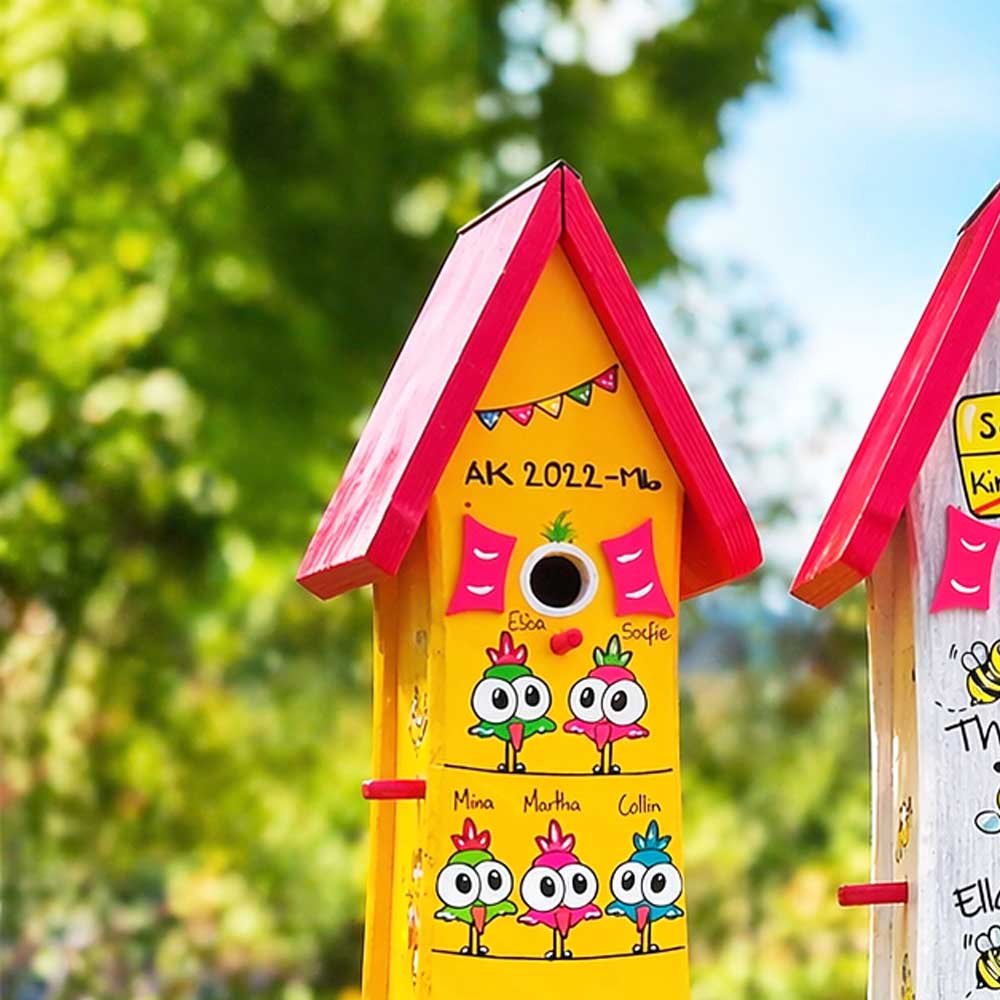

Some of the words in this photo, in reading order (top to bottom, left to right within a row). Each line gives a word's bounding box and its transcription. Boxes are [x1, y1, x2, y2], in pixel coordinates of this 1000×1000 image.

[465, 460, 514, 486] AK
[454, 788, 494, 811] Mina
[524, 788, 580, 813] Martha
[618, 794, 661, 816] Collin
